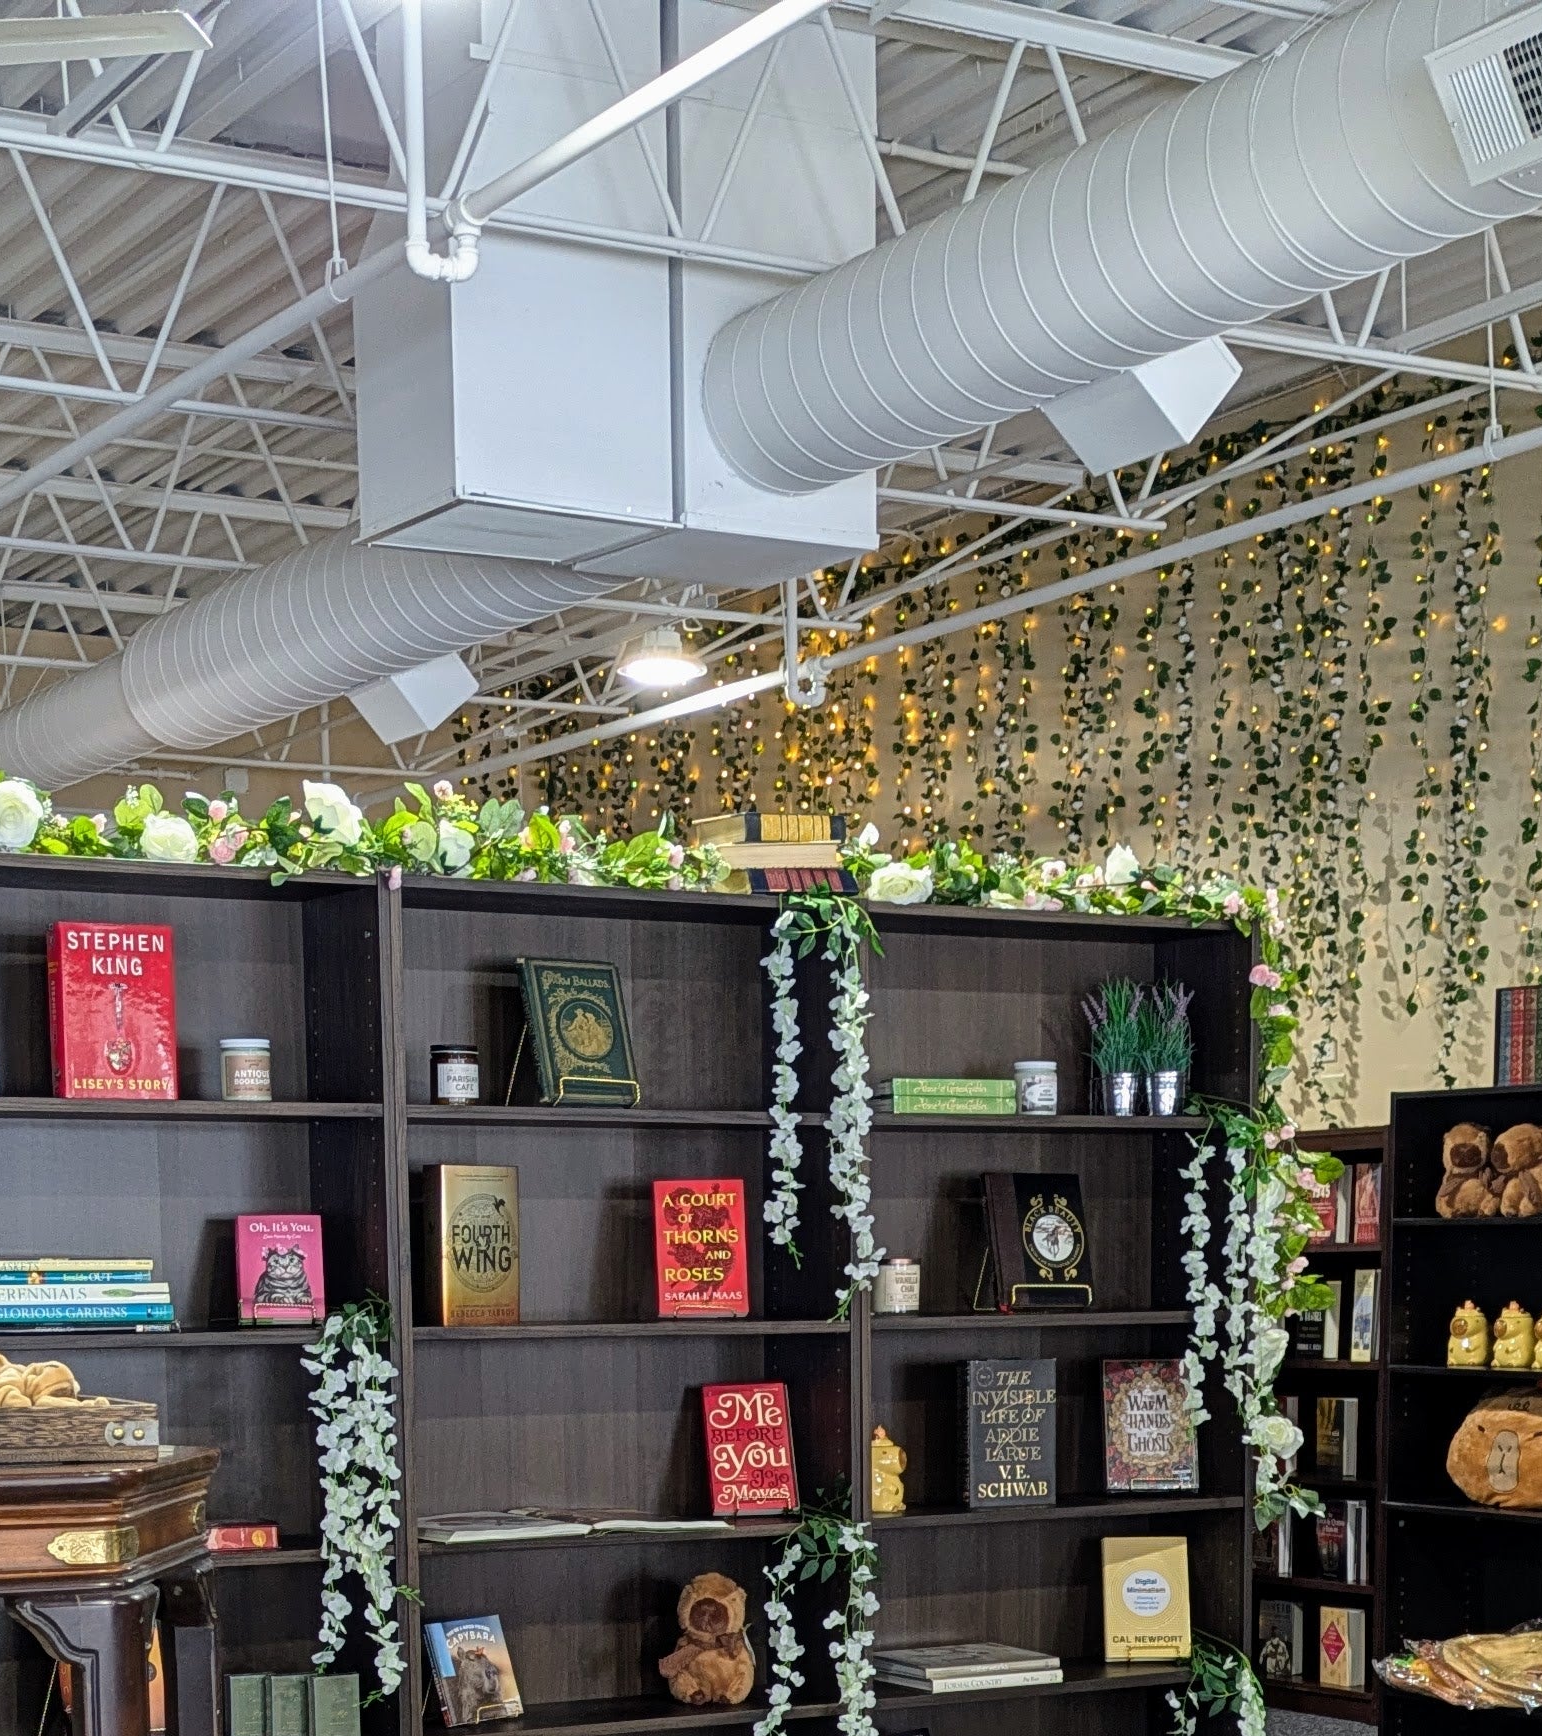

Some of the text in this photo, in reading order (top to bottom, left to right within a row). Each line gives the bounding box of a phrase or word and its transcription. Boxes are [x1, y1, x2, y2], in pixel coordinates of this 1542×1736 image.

[67, 931, 164, 952] STEPHEN
[92, 957, 142, 975] KING
[74, 1078, 169, 1090] LISEY'S STORY
[662, 1193, 737, 1208] A COURT
[678, 1213, 694, 1223] OF
[1024, 1205, 1082, 1233] BLACK BEAUTY
[249, 1222, 314, 1232] Oh. It's You.
[452, 1225, 511, 1244] FOURTH
[663, 1229, 739, 1245] THORNS
[453, 1246, 512, 1273] WING
[705, 1250, 731, 1260] AND
[664, 1267, 724, 1282] ROSES
[664, 1292, 699, 1300] SARAH
[712, 1291, 742, 1300] MAAS
[65, 1307, 128, 1318] GARDENS
[997, 1371, 1031, 1385] THE
[972, 1389, 1056, 1405] INVISIBLE
[710, 1392, 782, 1429] Me
[981, 1409, 1046, 1424] LIFE OF
[711, 1428, 783, 1448] BEFORE
[985, 1428, 1039, 1443] ADDIE
[985, 1447, 1041, 1462] LARUE
[999, 1465, 1031, 1480] V. E.
[718, 1484, 790, 1505] Moyes
[978, 1482, 1048, 1498] SCHWAB
[447, 1630, 496, 1648] CAPYBARA
[1135, 1635, 1183, 1643] NEWPORT
